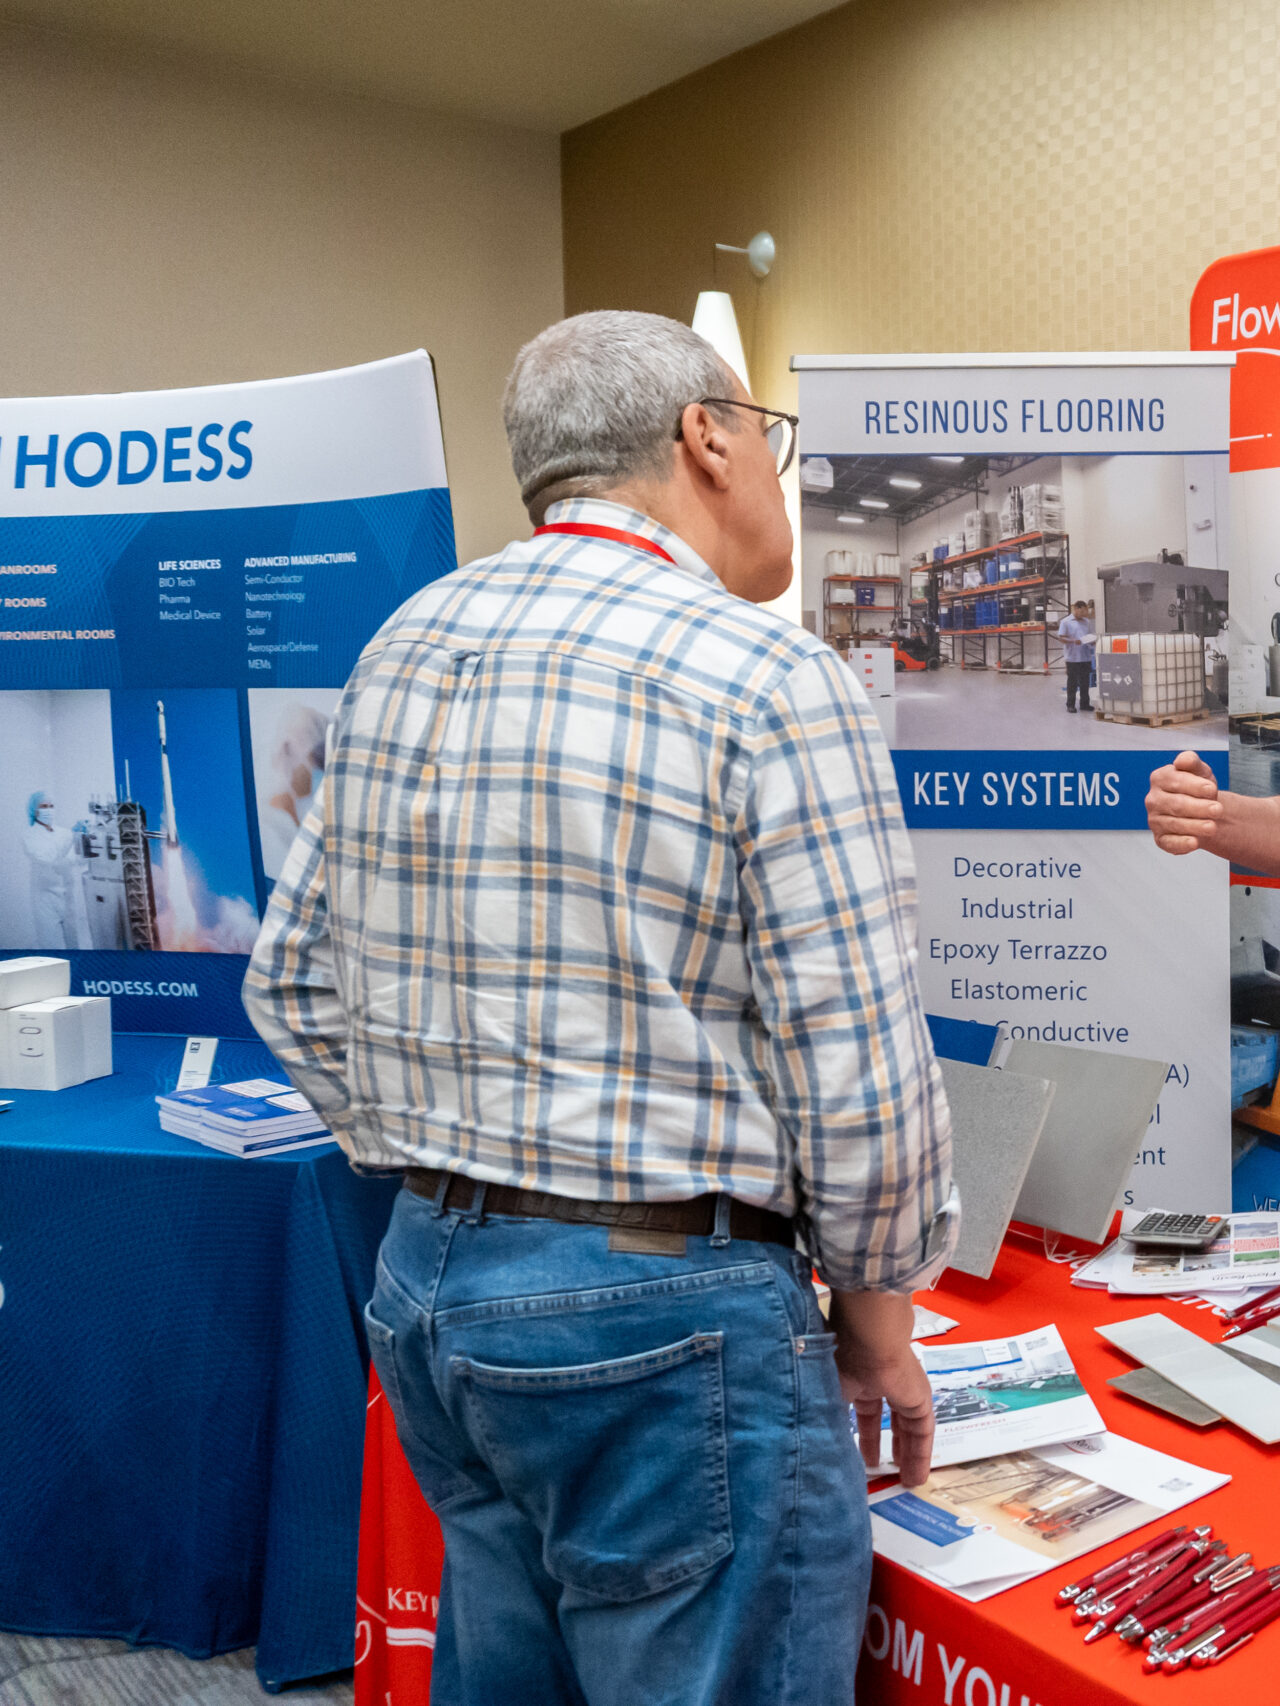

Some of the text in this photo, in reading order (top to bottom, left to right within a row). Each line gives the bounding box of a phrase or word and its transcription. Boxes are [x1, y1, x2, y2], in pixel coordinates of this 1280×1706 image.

[865, 398, 1166, 435] RESINOUS FLOORING
[14, 420, 254, 489] HODESS
[158, 559, 221, 571] LIFE SCIENCES
[244, 552, 357, 568] ADVANCED MANUFACTURING
[0, 564, 57, 575] ANROOMS
[159, 577, 196, 588] BIO Tech
[244, 573, 304, 585] Semi-Conductor
[4, 597, 47, 608] ROOMS
[159, 594, 191, 604] Pharma
[245, 592, 305, 603] Nanotechnology
[159, 609, 221, 621] Medical Device
[245, 608, 272, 621] Battery
[76, 629, 116, 640] ROOMS
[246, 625, 266, 636] Solar
[247, 642, 319, 654] Aerospace/Defense
[914, 771, 1121, 807] KEY SYSTEMS
[953, 856, 1082, 879] Decorative
[961, 898, 1074, 919] Industrial
[930, 939, 1108, 965] Epoxy Terrazzo
[84, 980, 199, 997] HODESS.COM
[951, 979, 1088, 1002] Elastomeric
[386, 1587, 429, 1613] KEY
